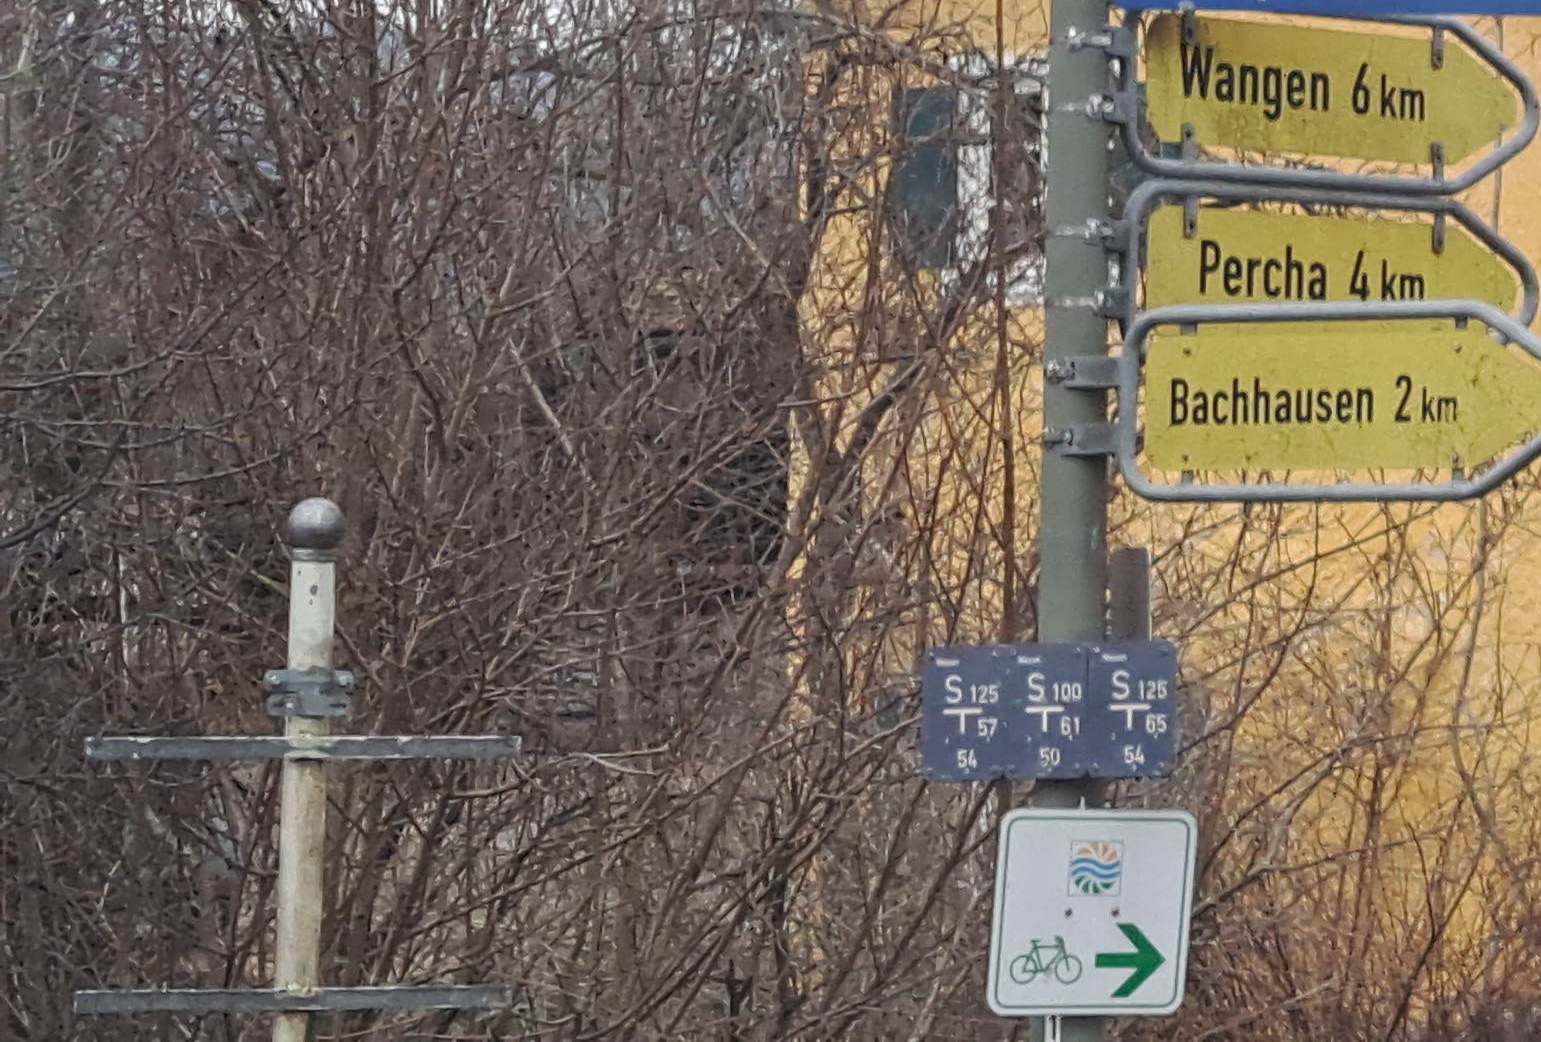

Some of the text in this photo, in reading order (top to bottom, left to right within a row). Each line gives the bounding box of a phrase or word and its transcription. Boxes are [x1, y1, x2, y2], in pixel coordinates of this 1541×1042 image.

[1180, 43, 1426, 122] Wangen 6 km
[1200, 240, 1426, 301] Percha 4 km
[1169, 376, 1459, 426] Bachhausen 2 km
[945, 674, 999, 705] S 125
[1027, 672, 1082, 704] S 100
[1112, 669, 1131, 700] S
